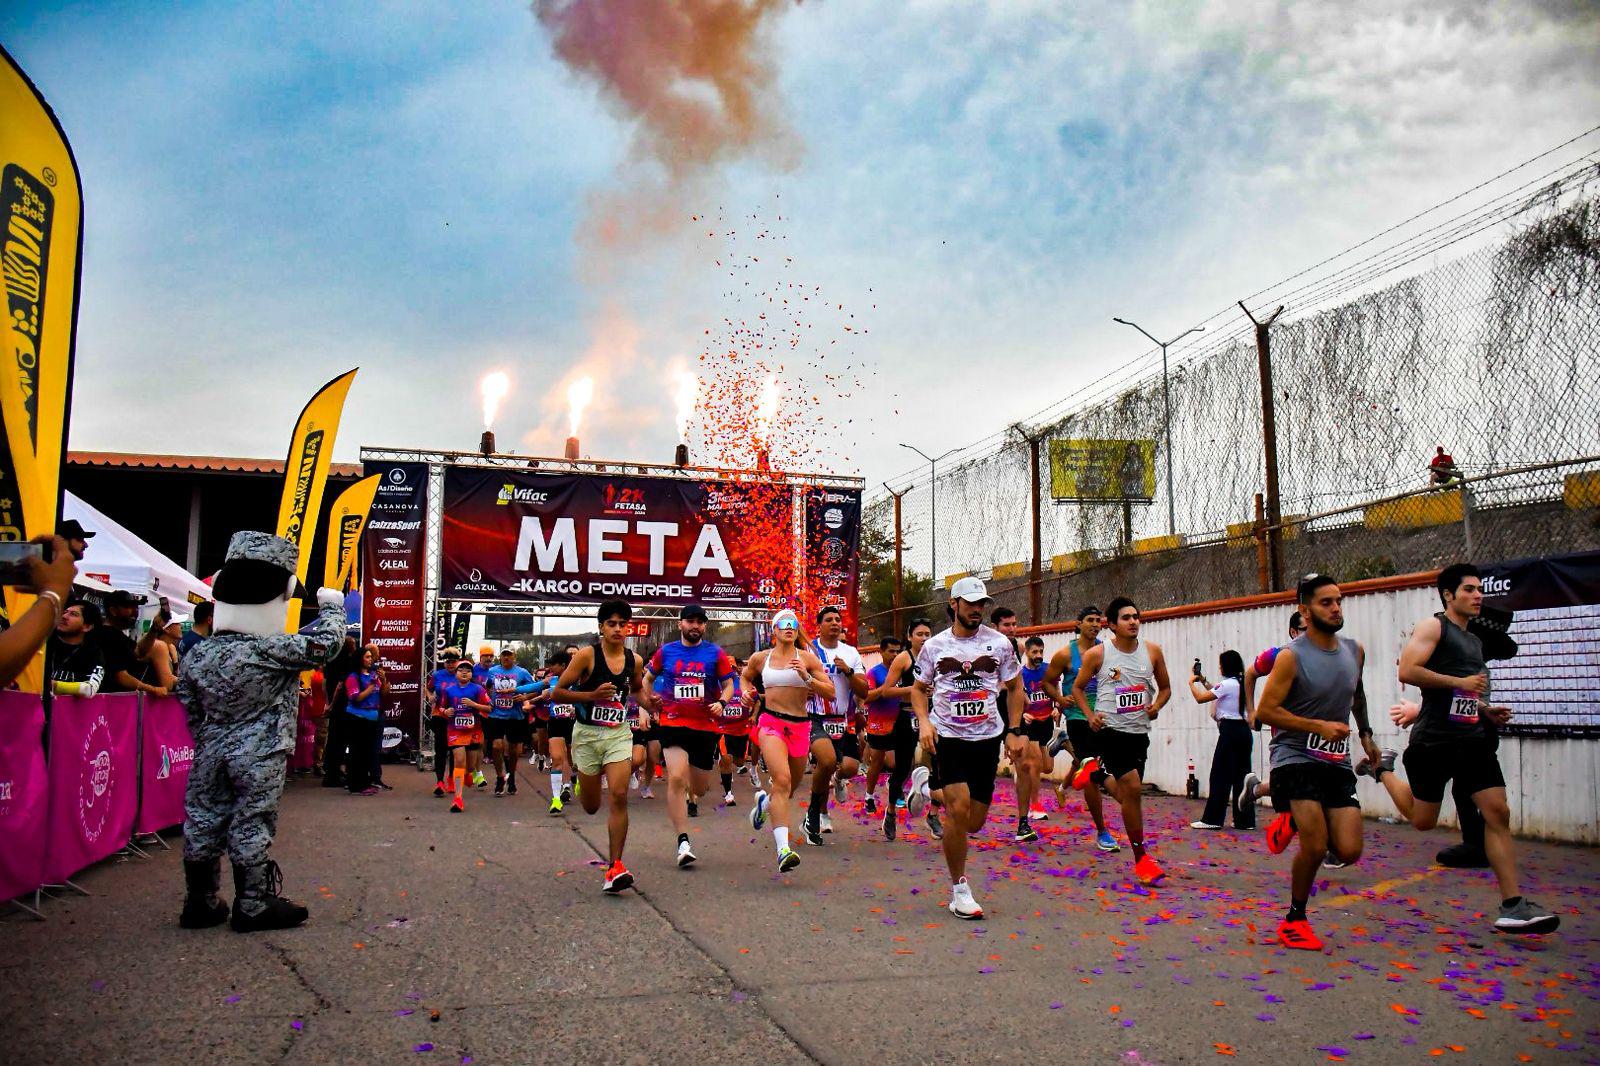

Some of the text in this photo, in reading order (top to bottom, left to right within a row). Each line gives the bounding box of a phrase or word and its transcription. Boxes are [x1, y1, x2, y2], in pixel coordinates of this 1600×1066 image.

[514, 488, 548, 501] Vifac
[614, 502, 647, 511] FETASA
[514, 516, 734, 578] META
[387, 560, 409, 569] LEAL
[521, 578, 583, 594] KARGO
[588, 582, 693, 597] POWERADE
[679, 686, 699, 698] 1111
[594, 707, 624, 722] 0824
[954, 701, 985, 716] 1132
